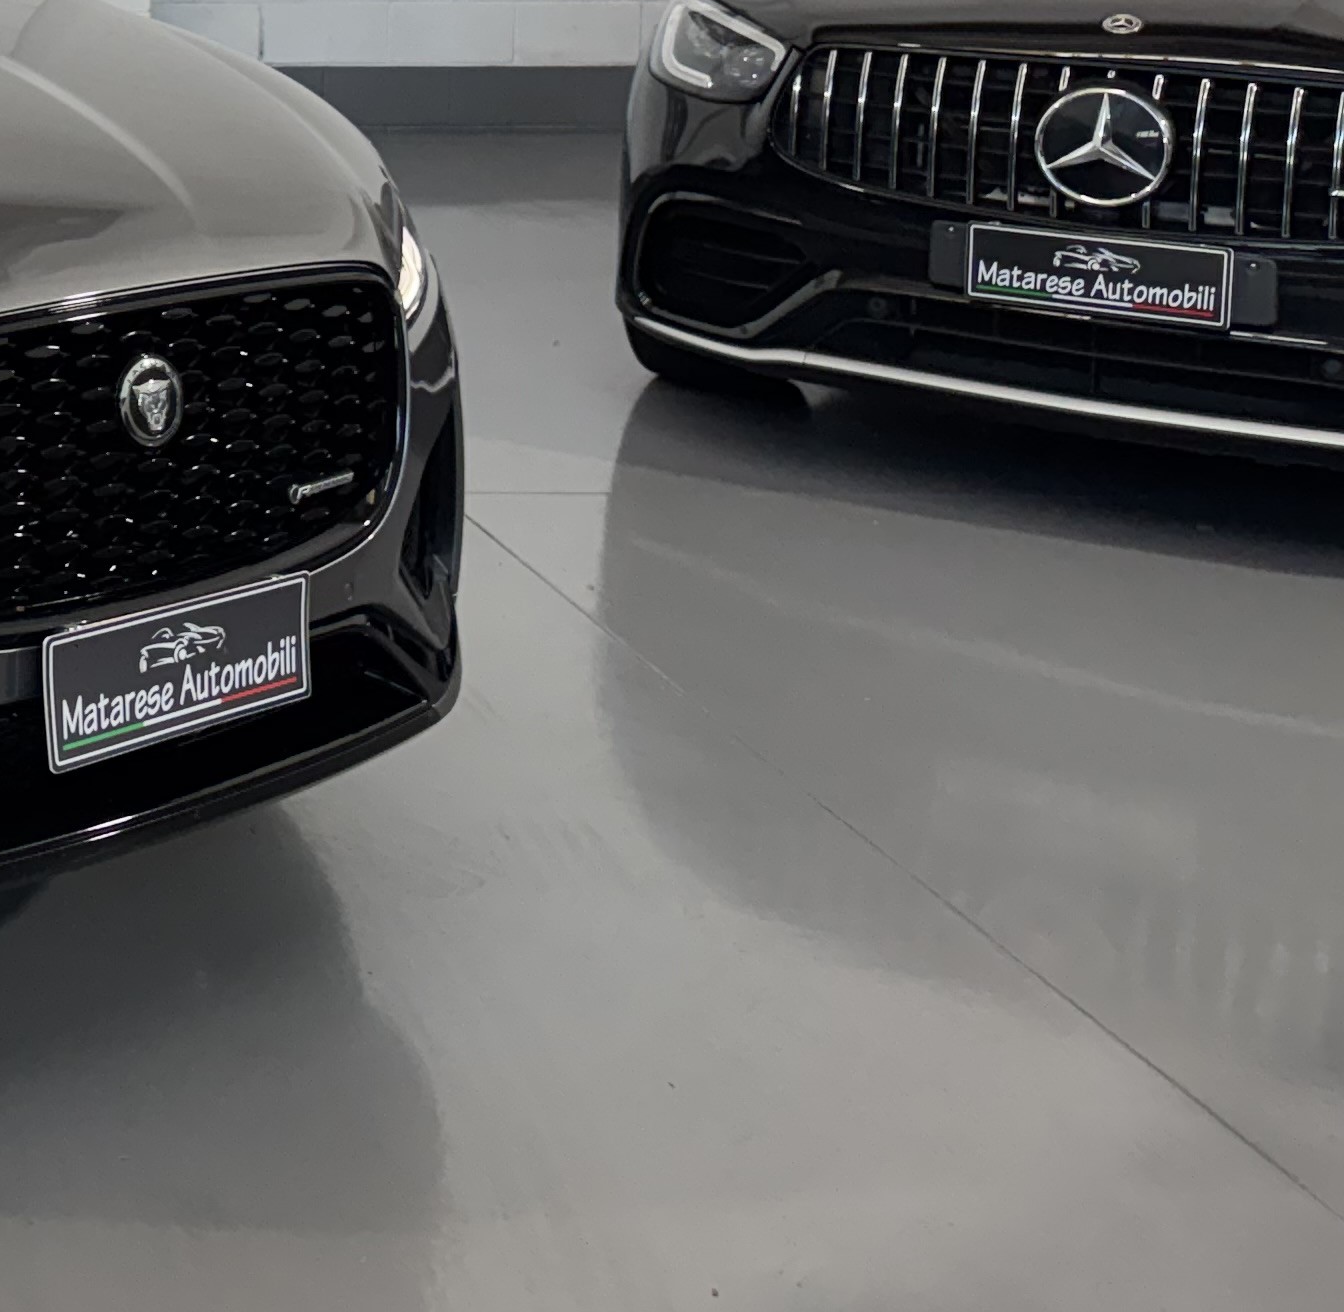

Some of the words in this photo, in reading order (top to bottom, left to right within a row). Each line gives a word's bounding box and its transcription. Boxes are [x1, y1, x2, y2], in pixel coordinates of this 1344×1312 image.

[977, 259, 1085, 296] Matarese
[1089, 273, 1216, 312] Automobili
[61, 681, 175, 741] Matarese
[179, 635, 297, 706] Automobili
